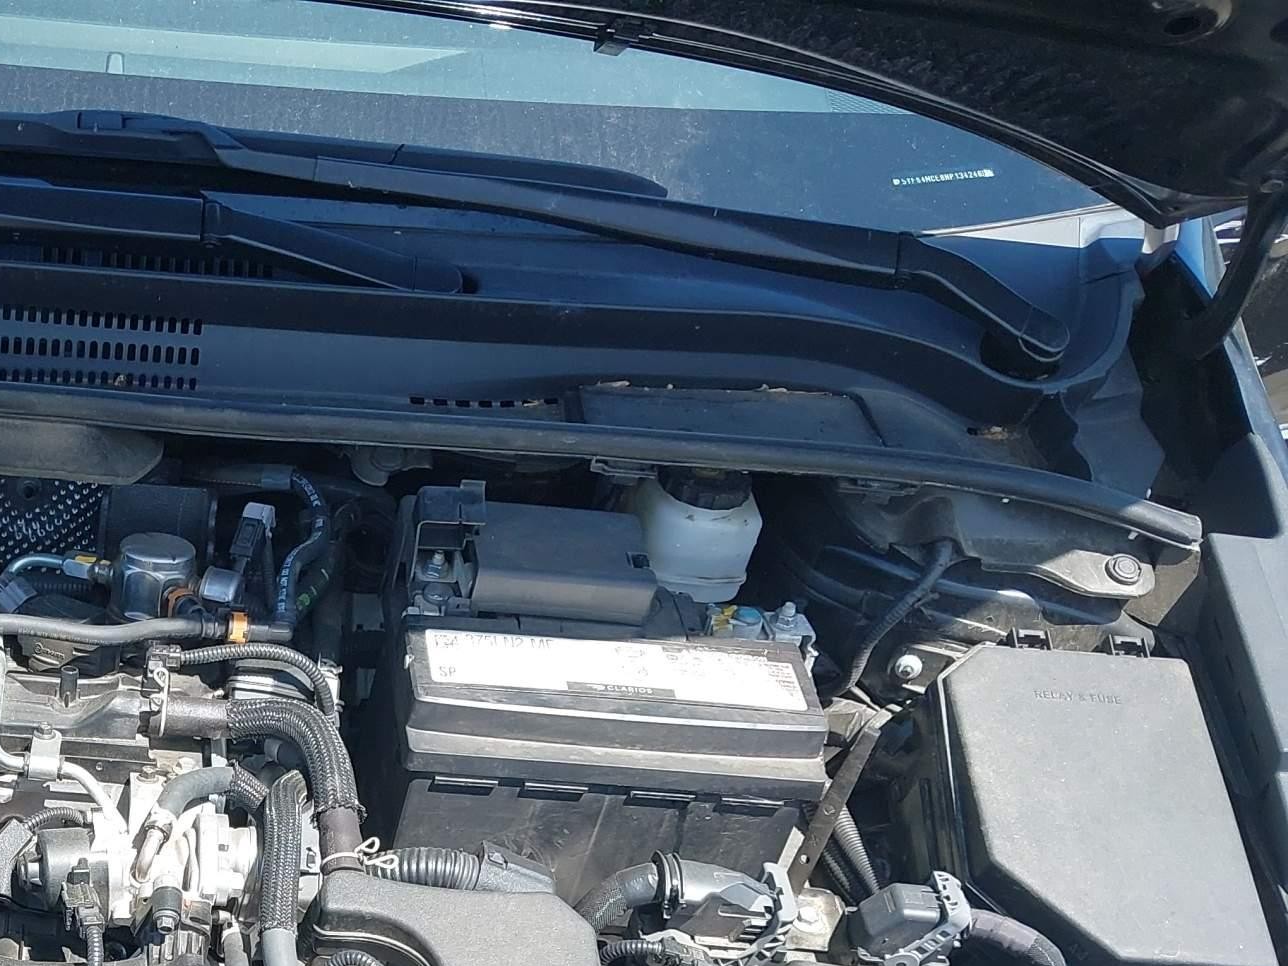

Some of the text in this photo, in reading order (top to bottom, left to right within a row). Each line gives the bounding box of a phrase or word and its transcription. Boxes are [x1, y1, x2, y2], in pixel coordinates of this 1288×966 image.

[606, 685, 653, 695] CLARIOS
[1033, 690, 1073, 701] RELAY
[1090, 694, 1123, 705] FUSE
